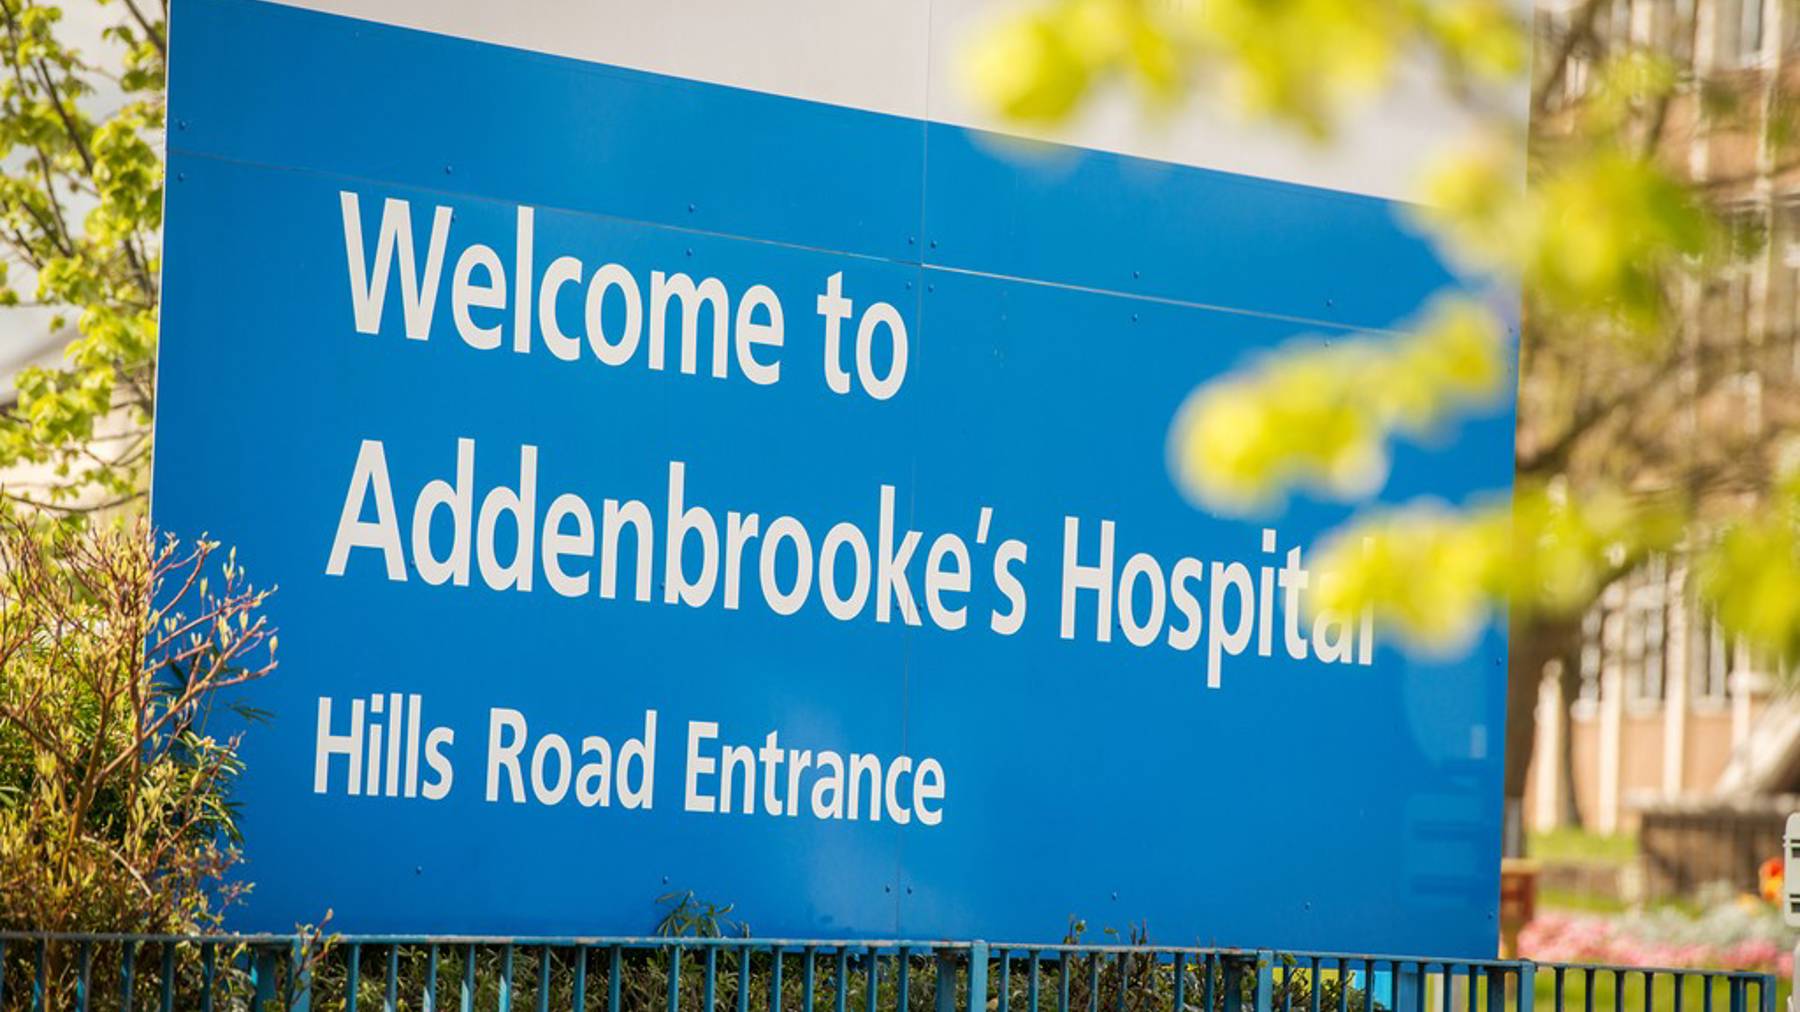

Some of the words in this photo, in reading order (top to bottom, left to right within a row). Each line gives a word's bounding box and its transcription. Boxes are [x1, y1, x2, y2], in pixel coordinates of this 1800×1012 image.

[341, 191, 784, 385] Welcome
[817, 272, 908, 400] to
[326, 438, 1028, 635] Addenbrooke's
[314, 694, 454, 800] Hills
[486, 708, 656, 811] Road
[685, 721, 945, 826] Entrance
